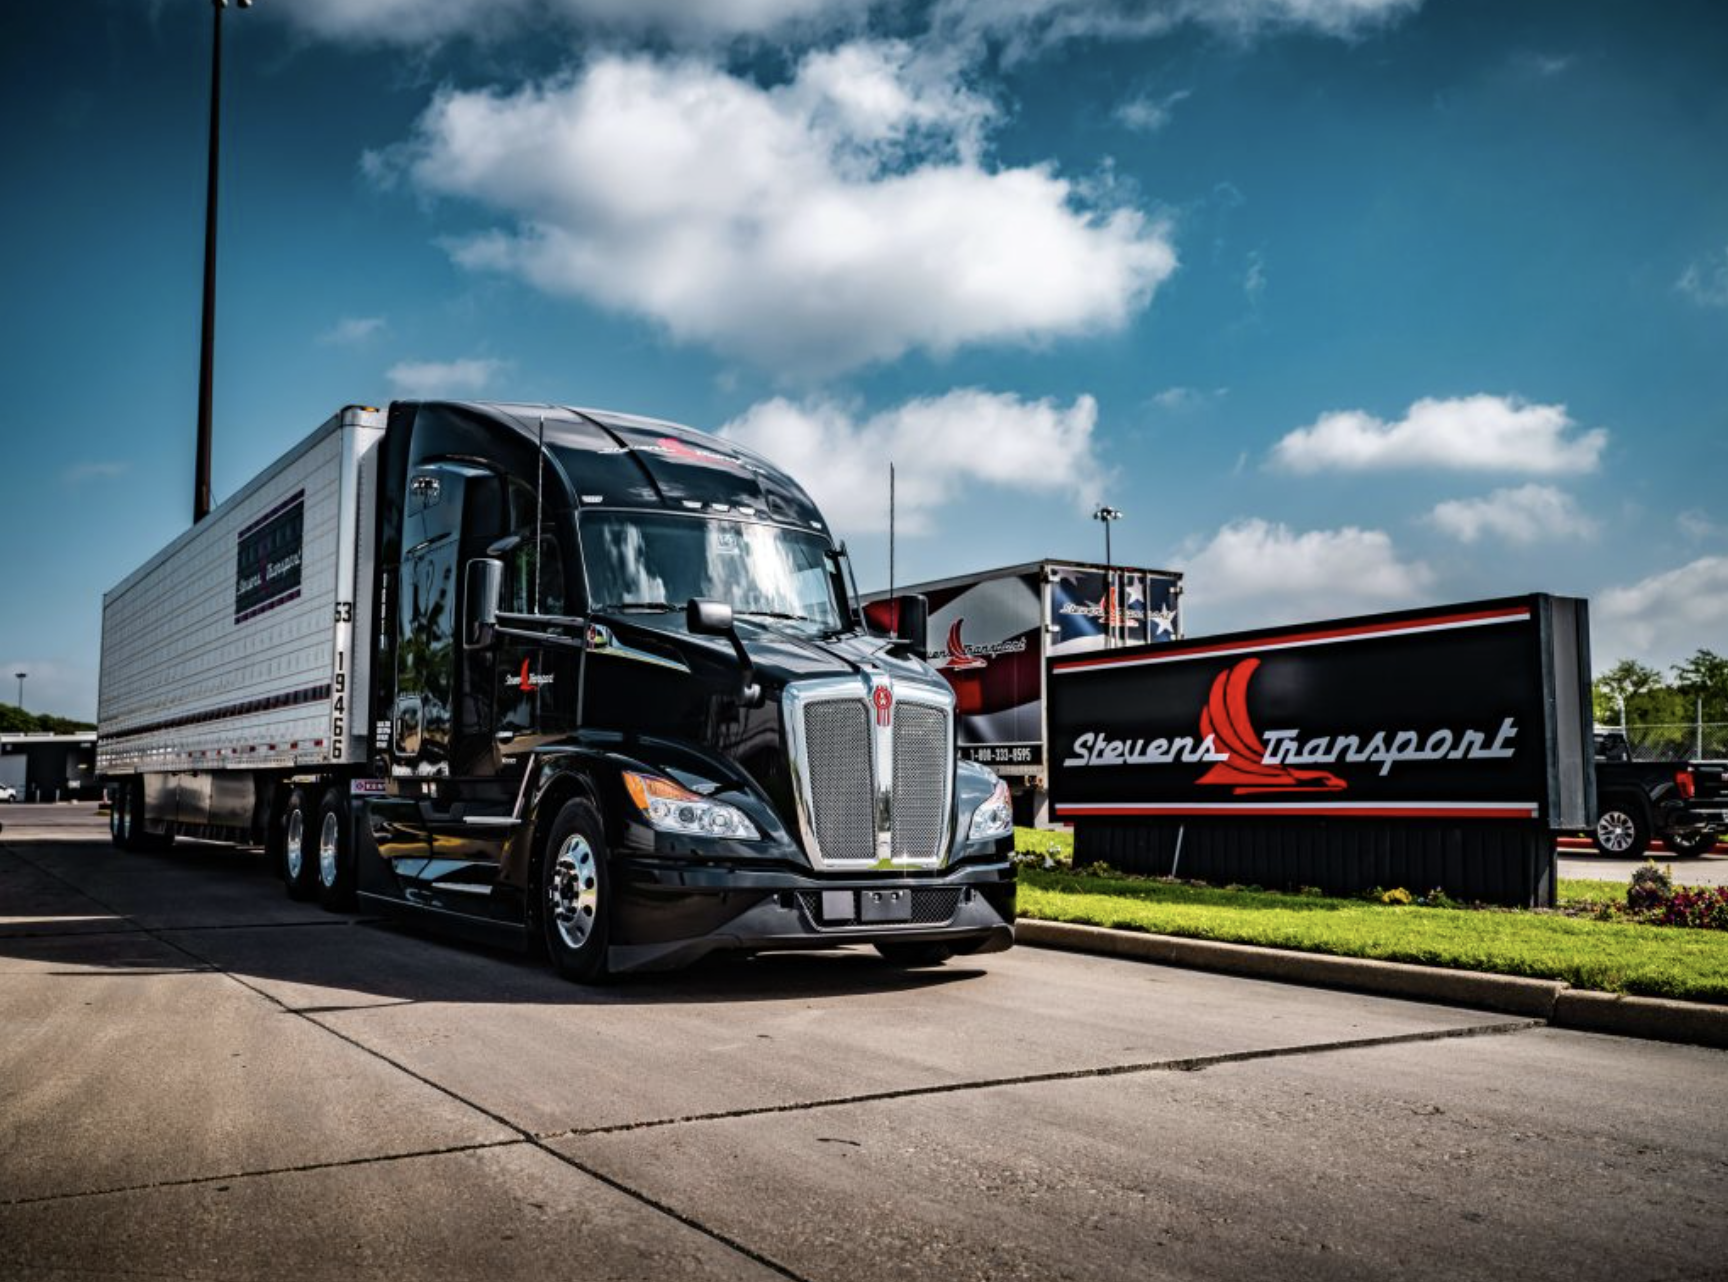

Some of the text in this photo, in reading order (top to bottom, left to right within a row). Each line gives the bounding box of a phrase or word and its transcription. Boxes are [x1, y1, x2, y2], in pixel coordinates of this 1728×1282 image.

[335, 602, 352, 623] 53
[332, 651, 345, 759] 19466
[1063, 717, 1519, 776] Stevens Transport
